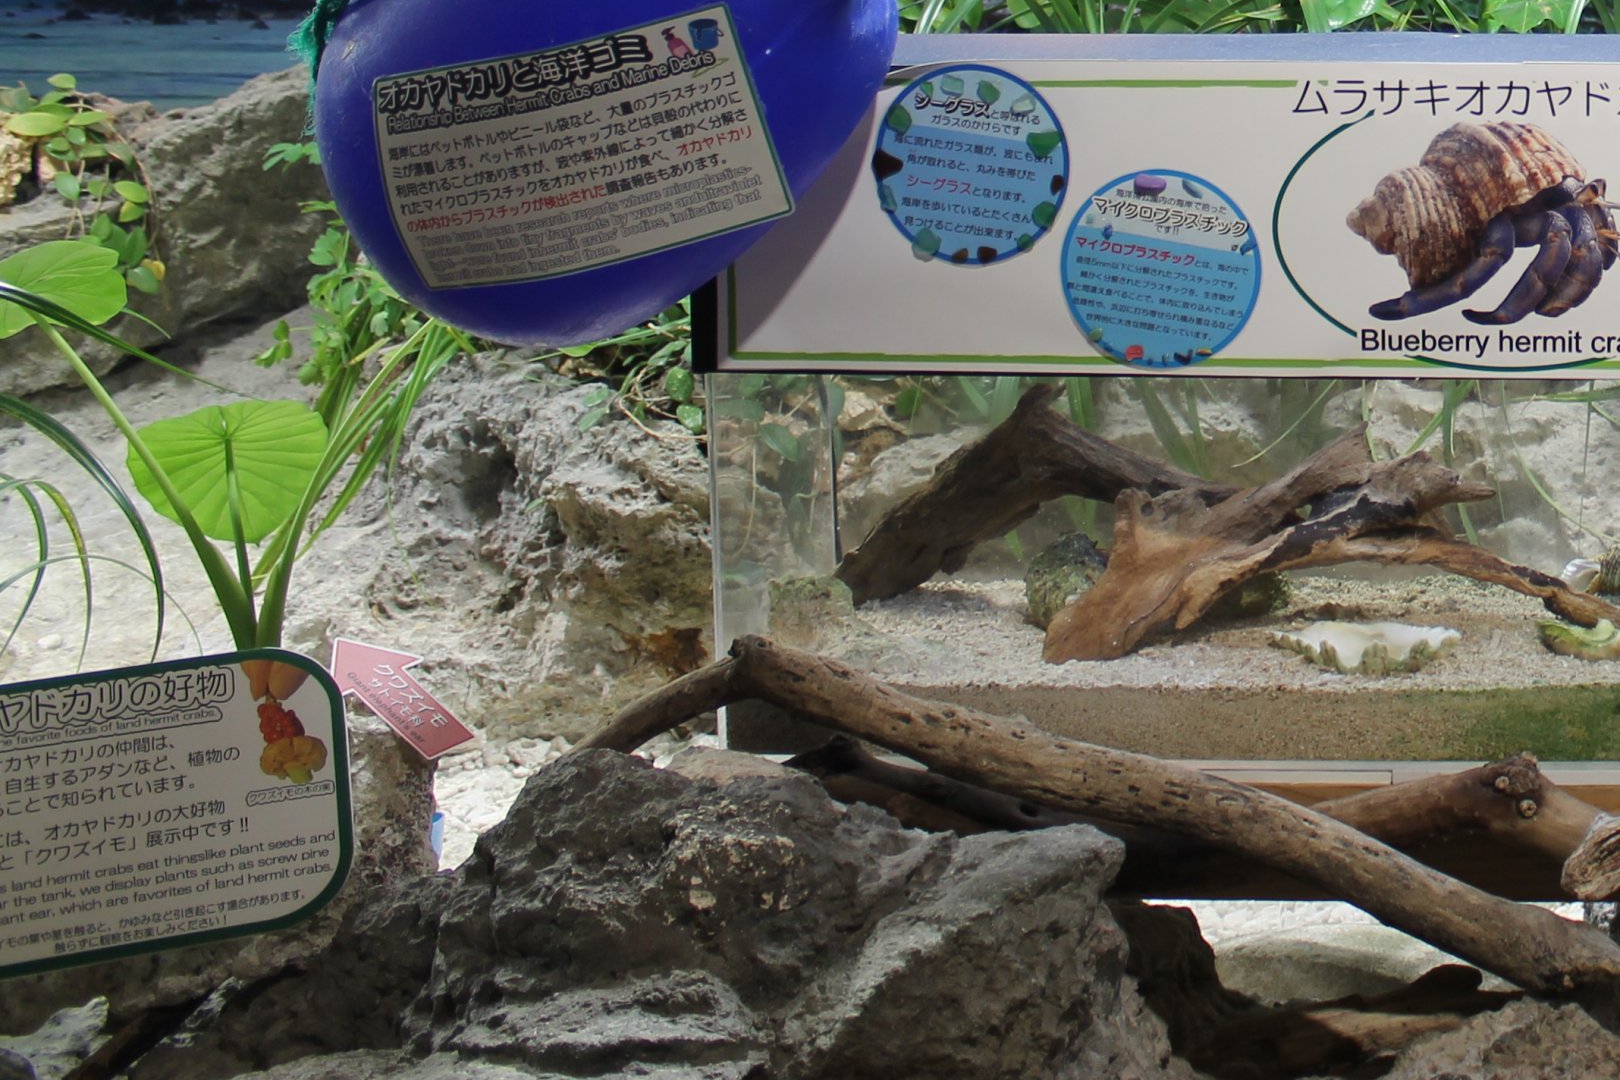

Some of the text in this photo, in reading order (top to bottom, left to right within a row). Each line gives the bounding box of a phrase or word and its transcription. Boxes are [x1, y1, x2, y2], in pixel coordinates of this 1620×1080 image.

[379, 33, 653, 113] オカヤドカリと海洋ゴミ
[386, 51, 716, 135] Relationship Between Hermit Crabs and Marine Debris
[1092, 196, 1249, 238] マイクロプラスチック
[1360, 328, 1491, 359] Blueberry
[1498, 329, 1584, 354] hermit
[373, 664, 448, 728] クワズイモ
[16, 708, 217, 746] favorite foods of land hermit crabs.
[12, 877, 42, 892] land
[47, 870, 90, 886] hermit
[95, 863, 134, 878] crabs
[137, 859, 160, 870] eat
[230, 843, 264, 858] plant
[268, 835, 306, 850] seeds
[310, 830, 335, 844] and
[14, 847, 329, 908] the tank, we display plants such as screw pine
[29, 862, 333, 922] ear, which are favorites of land hermit crabs.
